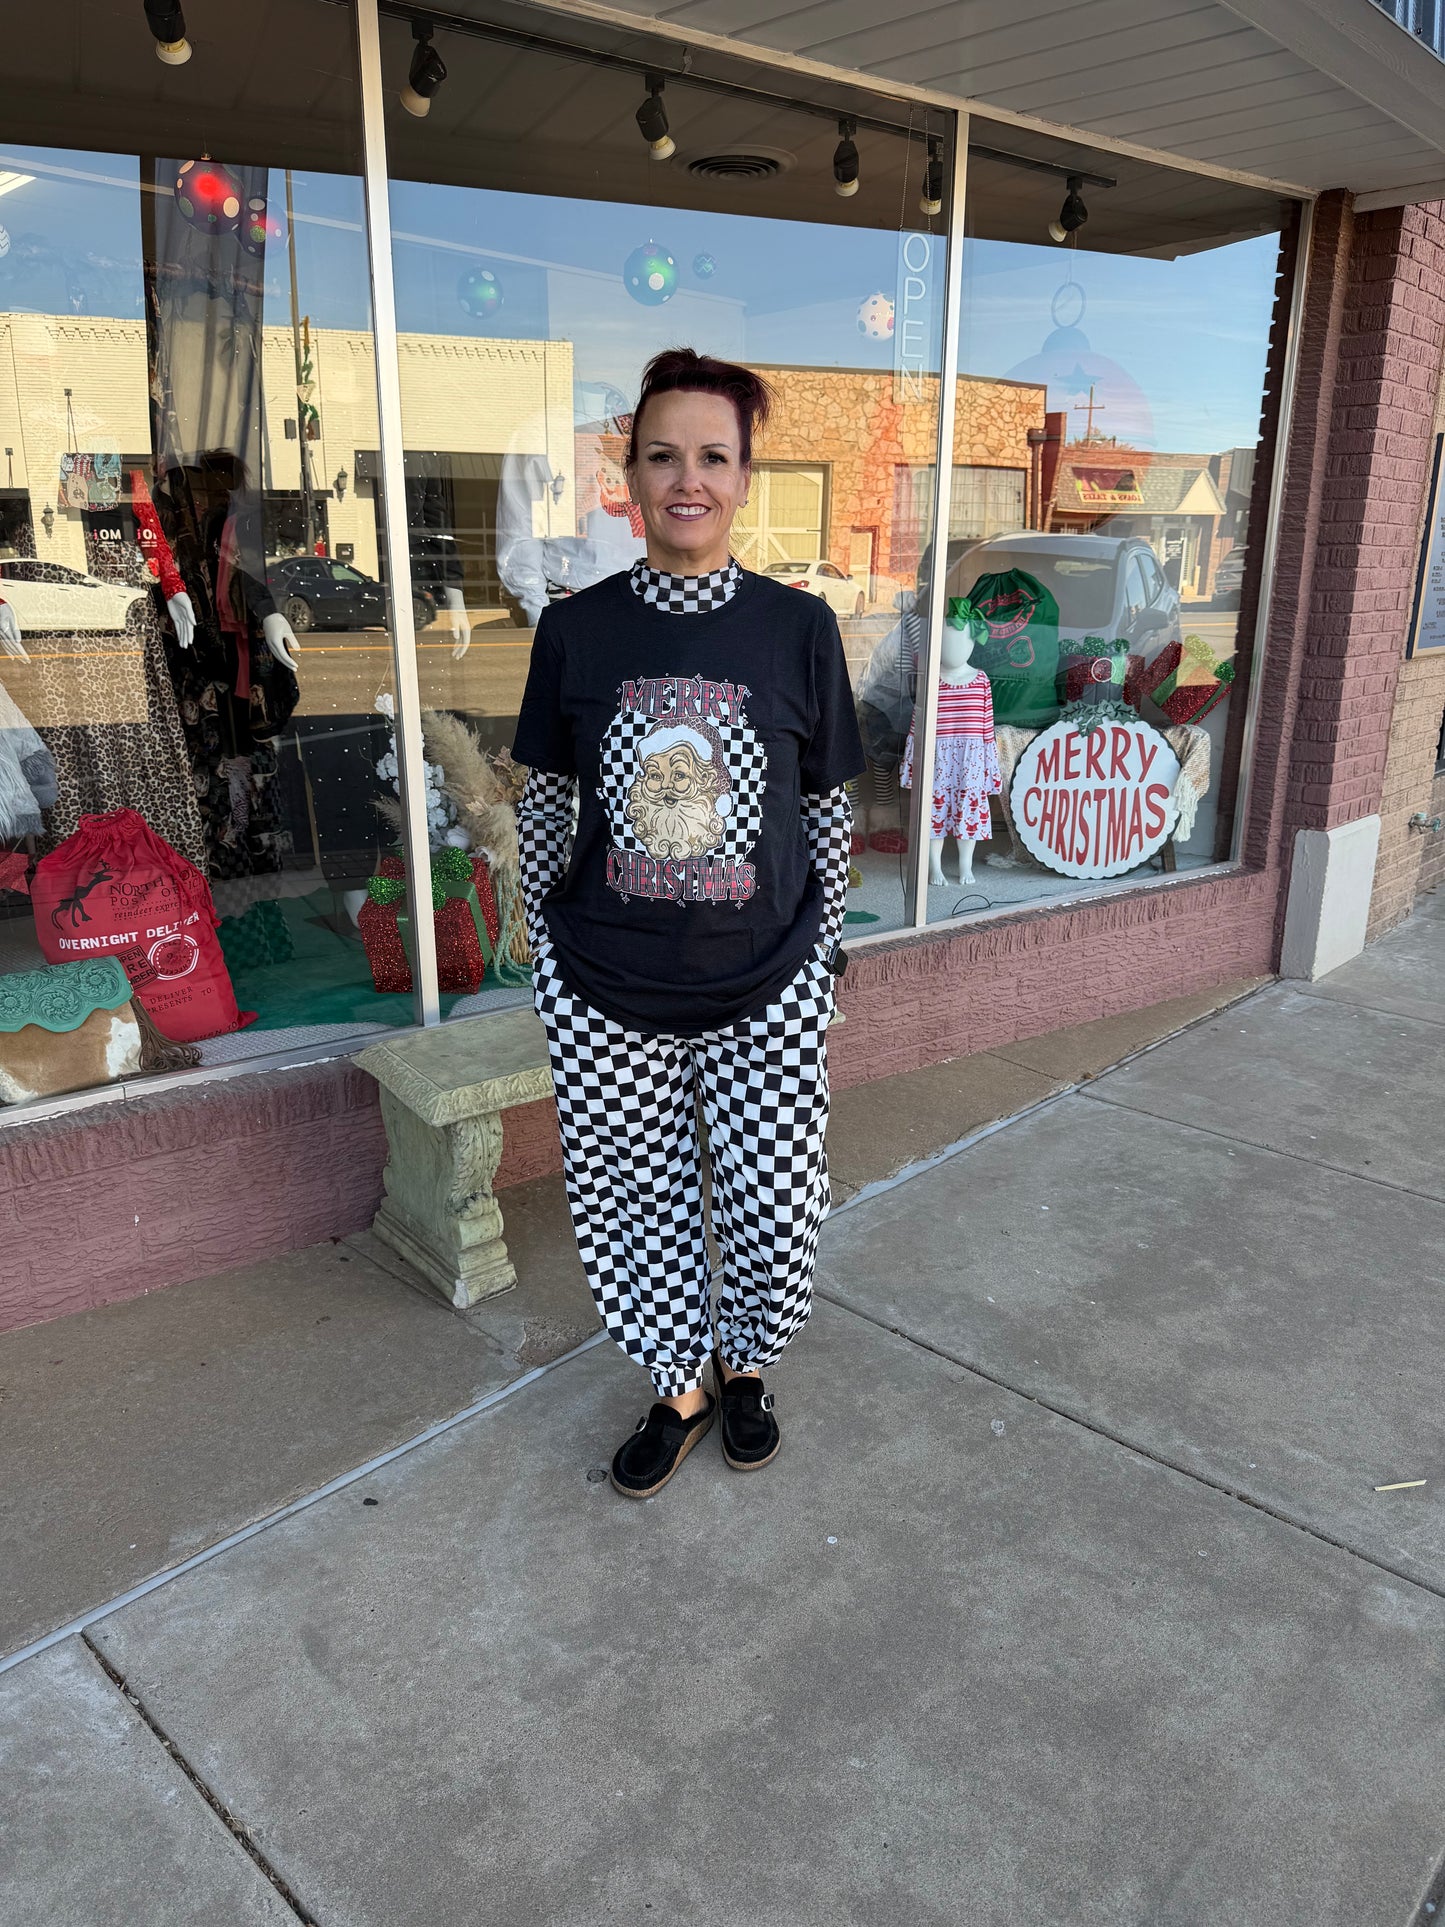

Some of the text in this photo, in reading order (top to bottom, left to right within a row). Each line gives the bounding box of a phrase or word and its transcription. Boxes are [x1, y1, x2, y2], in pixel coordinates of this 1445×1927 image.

[900, 232, 930, 400] OPEN
[620, 677, 747, 727] MERRY
[1034, 726, 1159, 785] MERRY
[1023, 783, 1170, 868] CHRISTMAS
[605, 847, 757, 902] CHRISTMAS
[110, 876, 165, 897] NORTH
[110, 893, 148, 906] POST
[114, 906, 152, 919] reindeer
[59, 931, 139, 950] OVERNIGHT
[118, 950, 141, 963] PEN
[149, 985, 193, 1005] DELIVER
